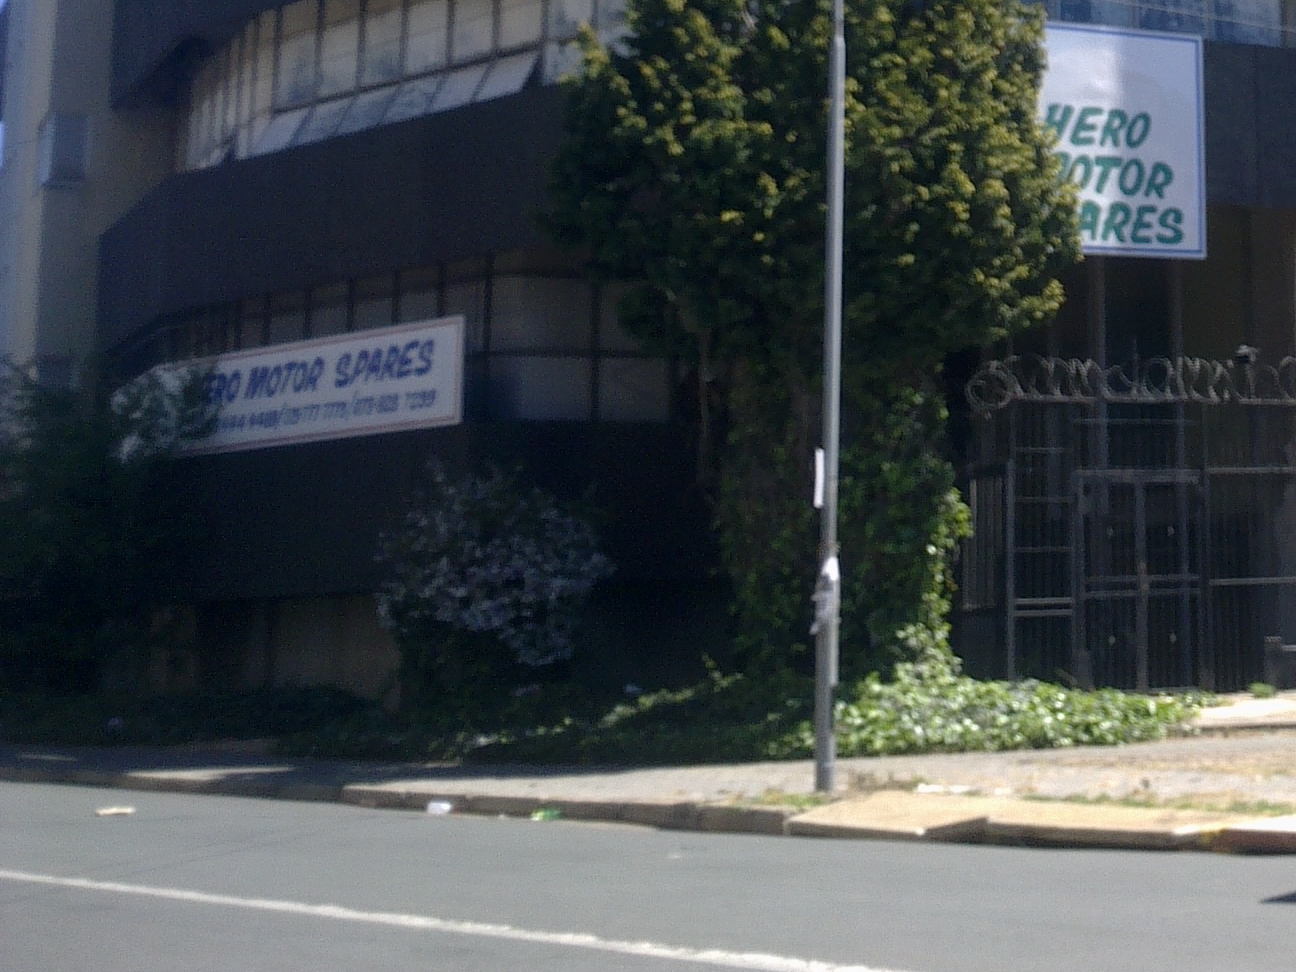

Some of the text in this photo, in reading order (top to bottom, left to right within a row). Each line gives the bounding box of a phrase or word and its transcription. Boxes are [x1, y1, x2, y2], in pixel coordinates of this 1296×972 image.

[1044, 103, 1152, 148] HERO
[1079, 199, 1184, 245] ARES
[244, 356, 325, 400] MOTOR
[335, 339, 434, 388] SPARES
